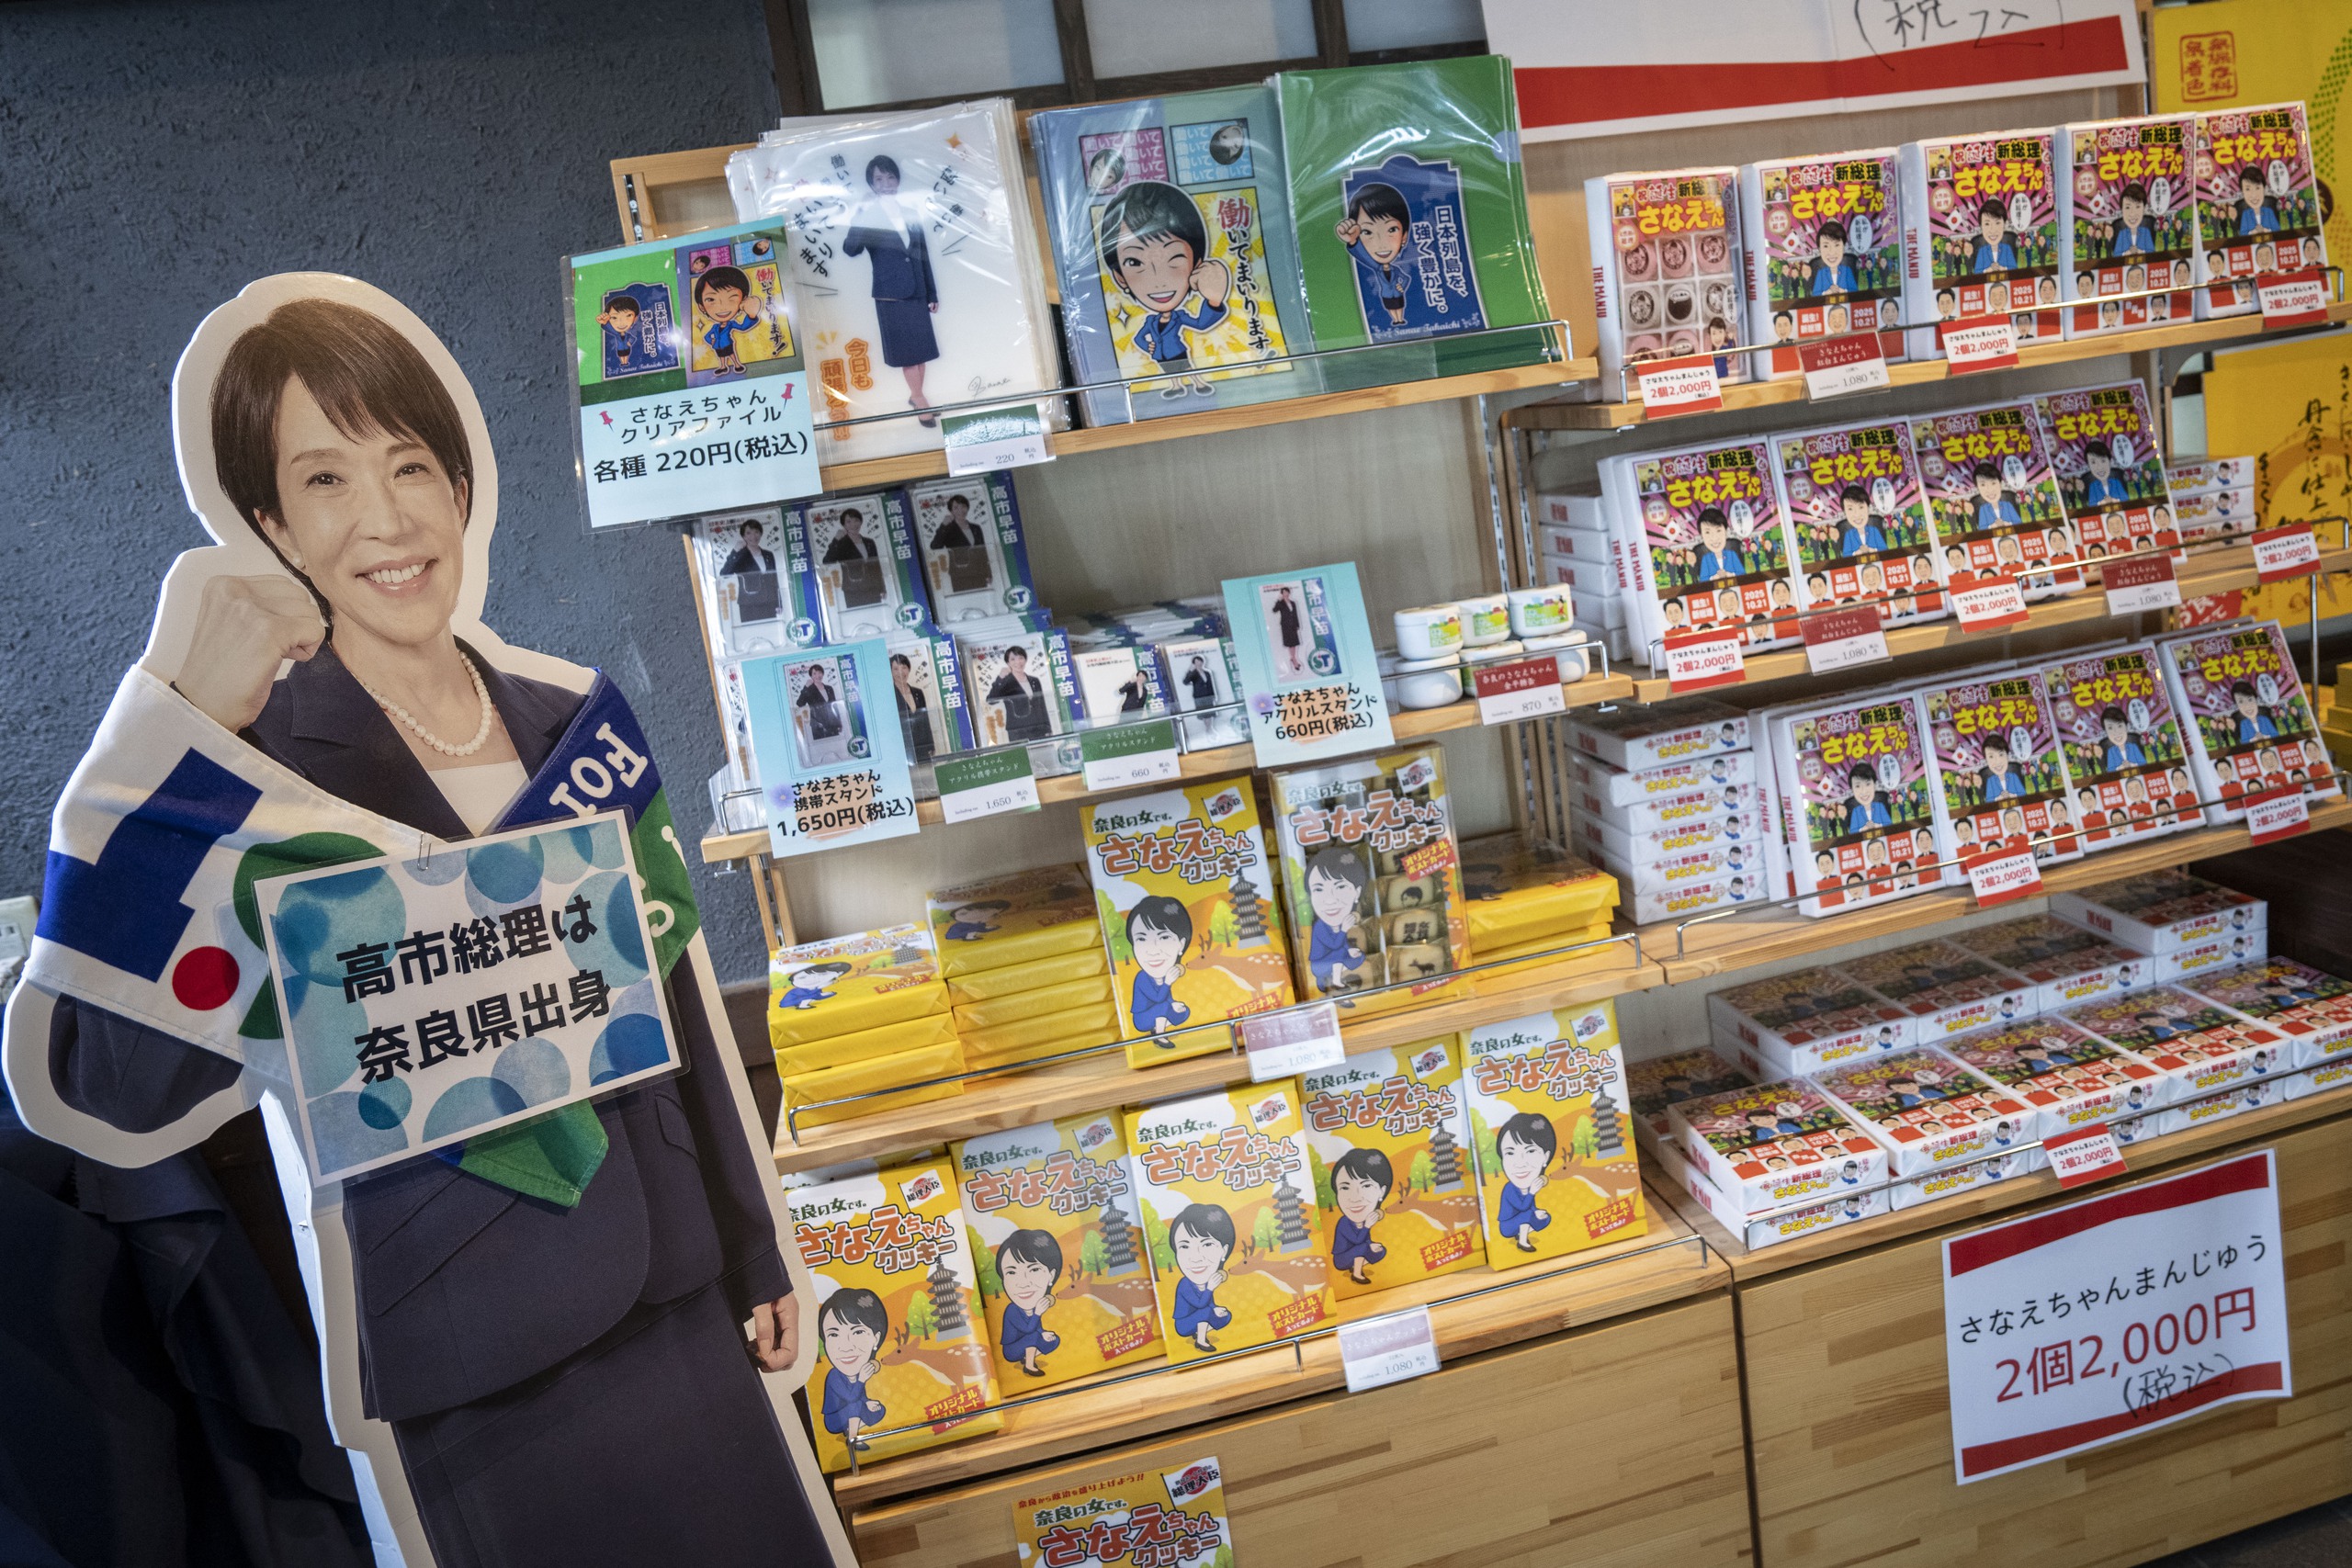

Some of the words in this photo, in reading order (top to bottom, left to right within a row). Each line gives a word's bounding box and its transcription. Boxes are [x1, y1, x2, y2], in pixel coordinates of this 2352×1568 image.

[2212, 131, 2297, 165] さなえちゃん
[2098, 147, 2184, 181] さなえちゃん
[1954, 162, 2043, 197] さなえちゃん
[1791, 184, 1884, 220] さなえちゃん
[1435, 205, 1468, 298] 日本列島を、
[1412, 221, 1449, 314] 強く豊かに。
[2013, 286, 2033, 296] 2025
[2014, 295, 2034, 306] 10.21
[2268, 295, 2319, 310] 2個2,000円
[1853, 307, 1874, 318] 2025
[1854, 317, 1875, 328] 10.21
[640, 310, 657, 357] 強く豊かに。
[1394, 326, 1421, 337] Sanae
[1953, 337, 2008, 355] 2個2,000円
[845, 338, 872, 389] 今日も
[1651, 380, 1712, 399] 2個2,000円
[1843, 374, 1868, 389] 1,080
[631, 389, 766, 423] さなえちゃん
[621, 407, 781, 445] クリアファイル
[594, 454, 647, 483] 各種
[656, 432, 808, 472] 220円(税込)
[996, 454, 1014, 465] 220
[1941, 429, 2031, 462] さなえちゃん
[1810, 448, 1903, 485] さなえちゃん
[1667, 470, 1761, 508] さなえちゃん
[885, 499, 913, 560] 高市早苗
[989, 485, 1018, 545] 高市早苗
[785, 511, 809, 574] 高市早苗
[1886, 565, 1907, 576] 2025
[1888, 574, 1909, 585] 10.21
[1744, 589, 1766, 601] 2025
[1746, 599, 1768, 610] 10.21
[1963, 596, 2018, 615] 2個2,000円
[1048, 633, 1076, 697] 高市早苗
[1676, 654, 1736, 672] 2個2,000円
[1842, 647, 1867, 660] 1,080
[933, 640, 963, 709] 高市早苗
[1273, 682, 1361, 707] さなえちゃん
[1521, 699, 1543, 713] 870
[1261, 695, 1377, 725] アクリルスタンド
[1953, 699, 2038, 734] さなえちゃん
[1275, 714, 1374, 740] 660円(税込)
[1820, 725, 1908, 765] さなえちゃん
[791, 769, 881, 797] さなえちゃん
[1131, 767, 1149, 778] 660
[794, 784, 883, 813] 携帯スタンド
[986, 795, 1012, 810] 1,650
[777, 796, 914, 838] 1,650円(税込)
[1092, 808, 1172, 834] 奈良の女です。
[1288, 788, 1443, 847] さなえちゃん
[1097, 818, 1256, 878] さなえちゃん
[1371, 821, 1445, 852] クッキー
[1891, 840, 1909, 850] 2025
[1180, 852, 1257, 885] クッキー
[1404, 840, 1449, 867] オリジナル
[1408, 850, 1452, 874] ポストカード
[1979, 866, 2032, 888] 2個2,000円
[336, 894, 597, 1003] 高市総理は
[355, 969, 611, 1084] 奈良県出身
[1469, 1032, 1543, 1055] 奈良の女です。
[1305, 1069, 1381, 1092] 奈良の女です。
[1472, 1039, 1615, 1096] さなえちゃん
[1547, 1070, 1617, 1100] クッキー
[1308, 1075, 1456, 1131] さなえちゃん
[1137, 1118, 1217, 1142] 奈良の女です。
[1385, 1106, 1457, 1136] クッキー
[962, 1145, 1044, 1170] 奈良の女です。
[1141, 1126, 1299, 1185] さなえちゃん
[2059, 1147, 2113, 1170] 2個2,000円
[967, 1150, 1126, 1213] さなえちゃん
[1224, 1158, 1302, 1191] クッキー
[1051, 1181, 1128, 1215] クッキー
[1587, 1201, 1629, 1224] オリジナル
[1589, 1208, 1634, 1232] ポストカード
[794, 1204, 955, 1269] さなえちゃん
[1422, 1233, 1466, 1256] オリジナル
[875, 1238, 957, 1275] クッキー
[1425, 1241, 1470, 1264] ポストカード
[1960, 1234, 2267, 1344] さなえちゃんまんじゅう
[1272, 1297, 1317, 1322] オリジナル
[1274, 1303, 1320, 1328] ポストカード
[1099, 1318, 1147, 1344] オリジナル
[1102, 1327, 1151, 1353] ポストカード
[1995, 1286, 2256, 1404] 2個2,000円
[1385, 1359, 1413, 1375] 1,080
[2122, 1353, 2236, 1419] (税込)
[929, 1388, 978, 1418] オリジナル
[1171, 1468, 1220, 1498] 総理大臣
[1034, 1498, 1128, 1527] 奈良の女です。
[1037, 1502, 1220, 1568] さなえちゃん
[1132, 1534, 1221, 1568] クッキー
